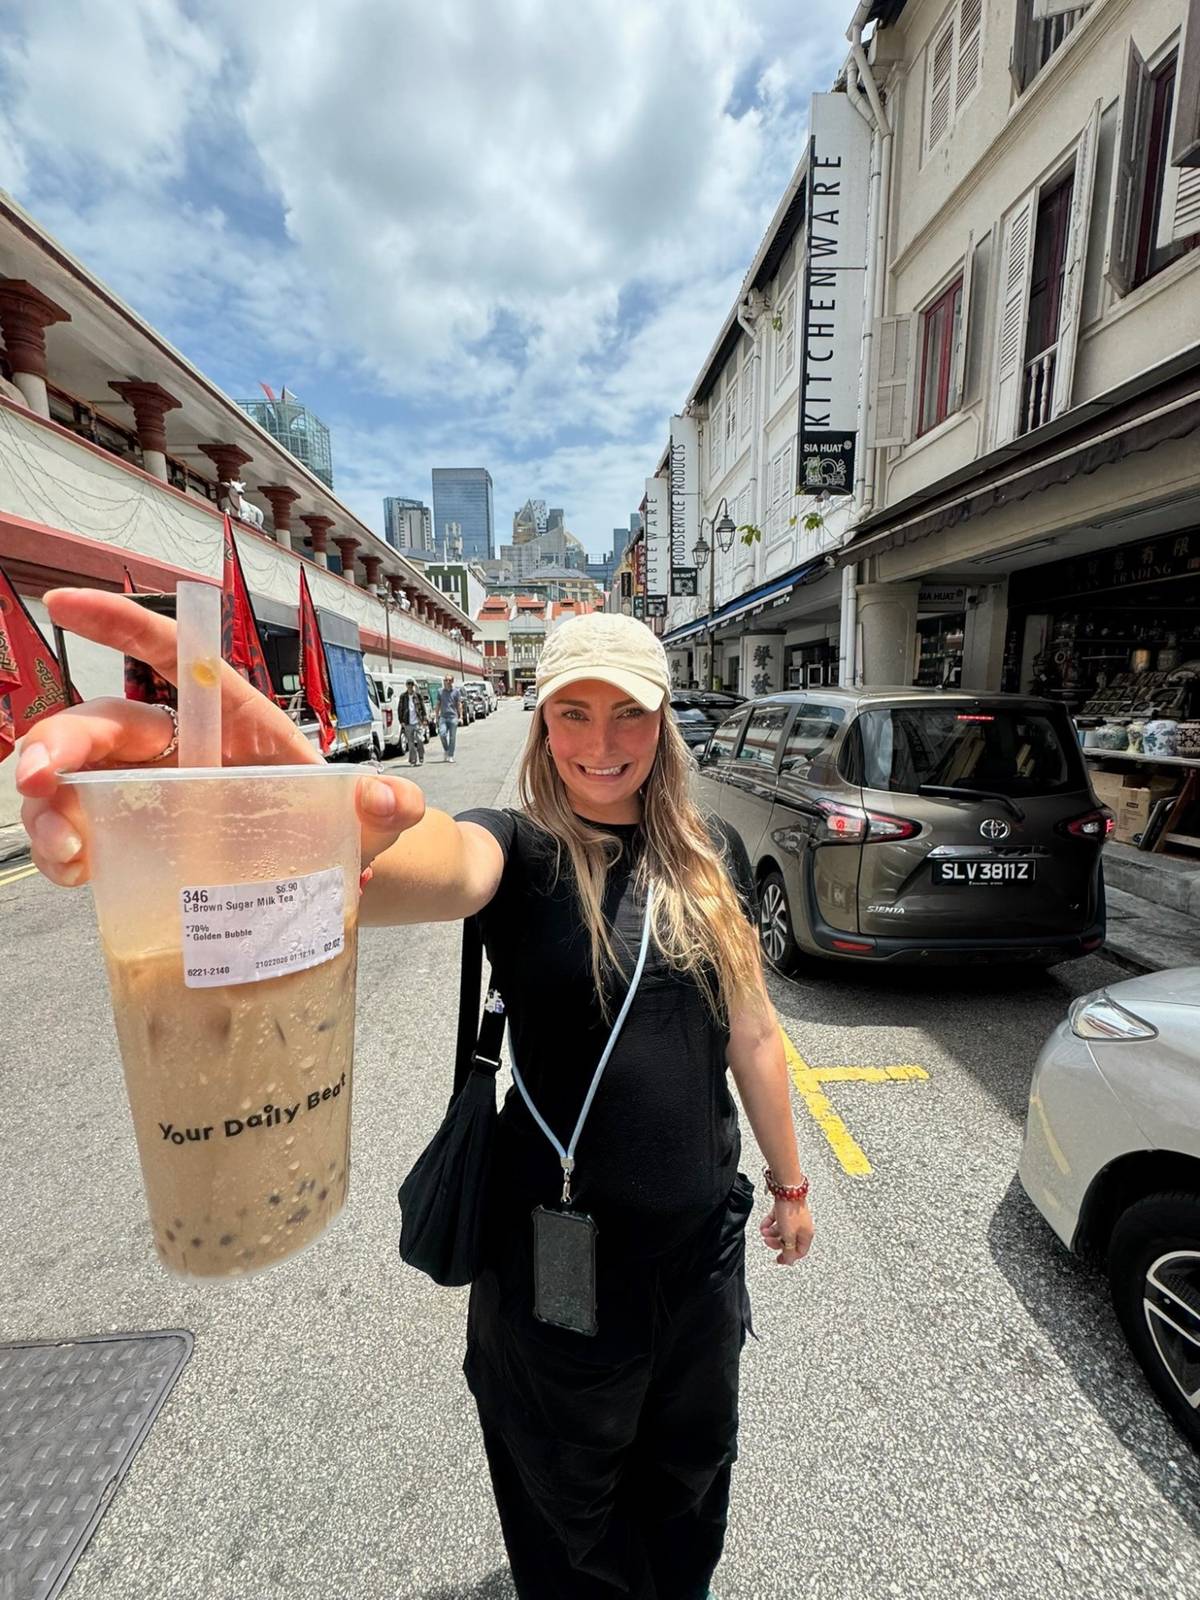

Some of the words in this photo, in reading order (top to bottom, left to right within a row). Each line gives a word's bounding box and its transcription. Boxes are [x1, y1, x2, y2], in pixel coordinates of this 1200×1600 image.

[803, 155, 842, 429] KITCHENWARE
[803, 443, 819, 453] SIA
[820, 443, 843, 453] HUAT
[673, 444, 685, 495] PRODUCTS
[673, 501, 685, 567] FOODSERVICE
[941, 863, 1029, 880] SLV3811Z
[183, 889, 208, 904] 346
[276, 882, 298, 894] $6.90
[184, 902, 223, 913] L-Brown
[226, 900, 254, 912] Sugar
[257, 896, 276, 907] Milk
[279, 894, 294, 904] Tea
[867, 905, 905, 914] SIENTA
[193, 932, 222, 941] Golden
[225, 928, 253, 938] Bubble
[158, 1122, 214, 1145] Your
[224, 1104, 300, 1137] Daily
[307, 1072, 346, 1110] Beat
